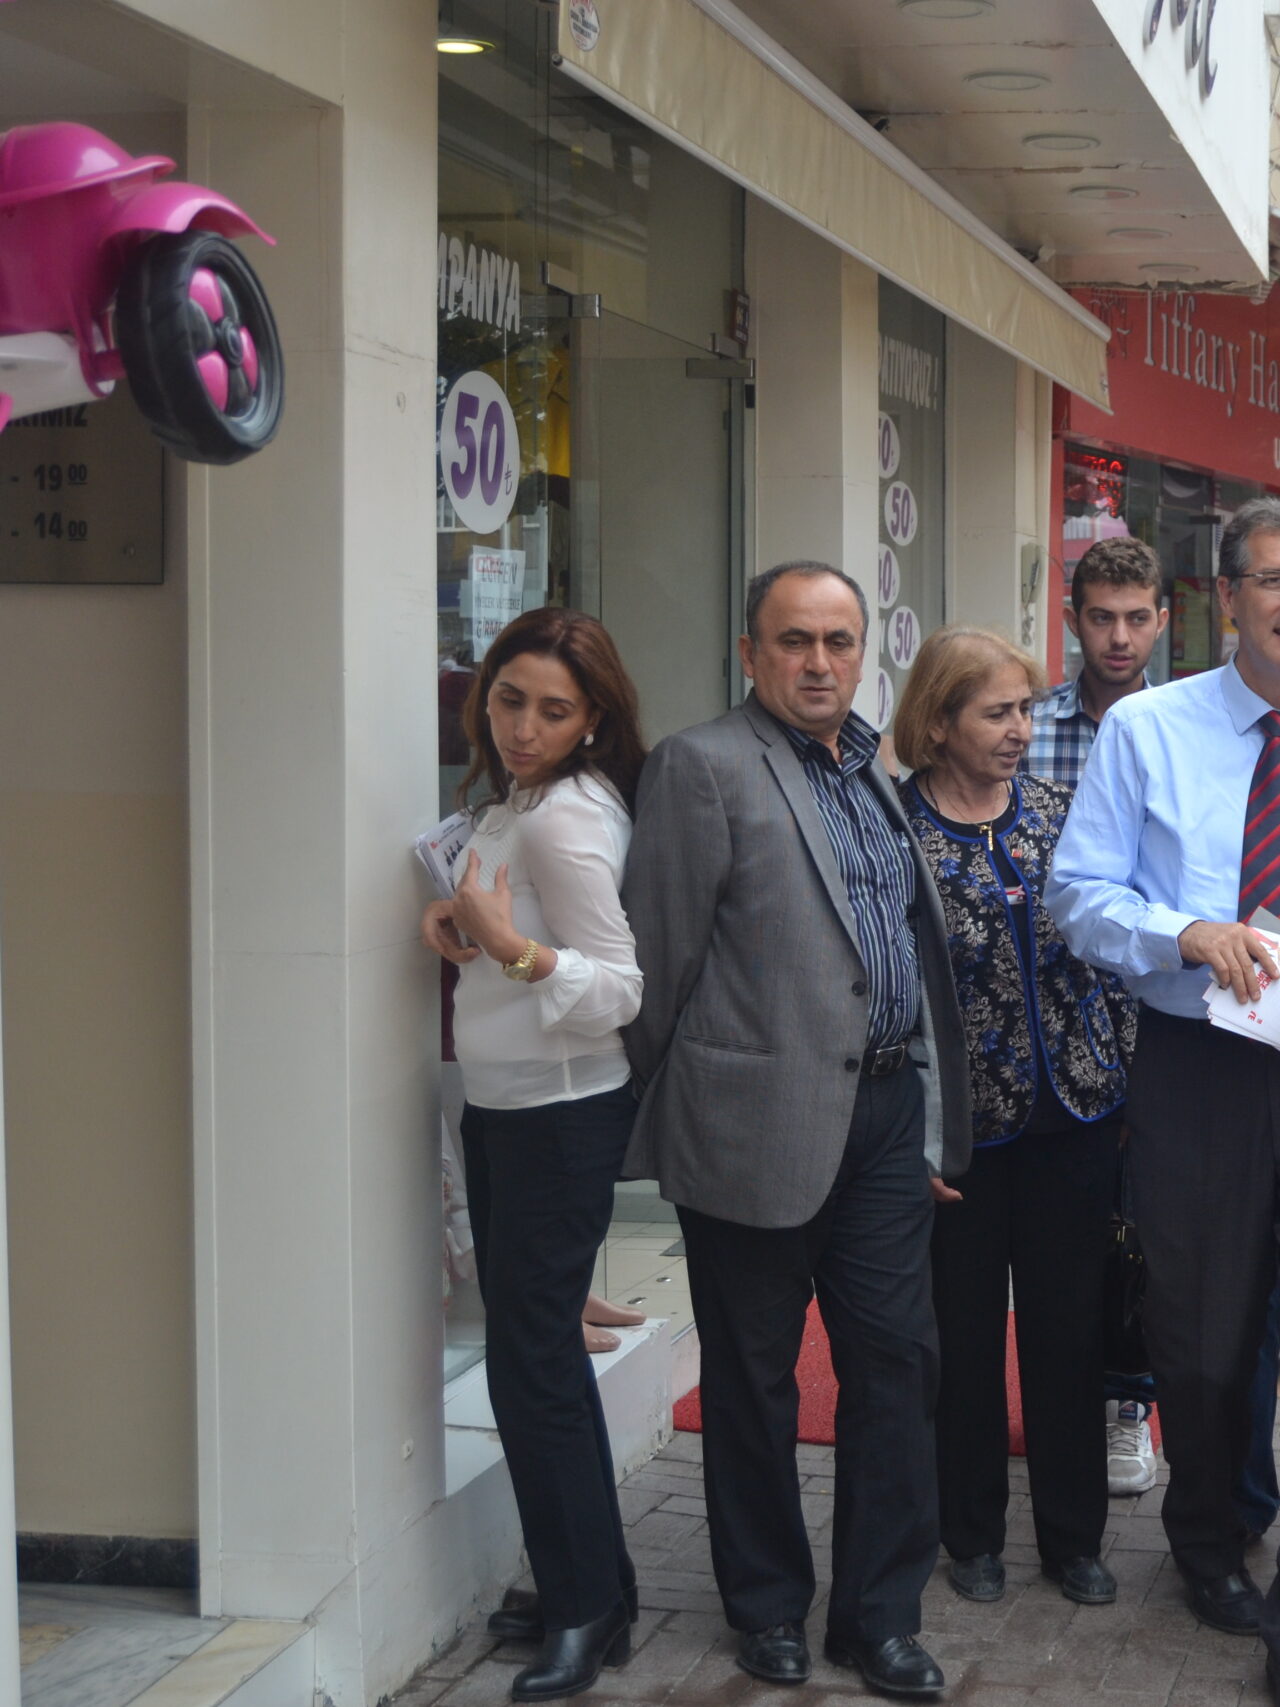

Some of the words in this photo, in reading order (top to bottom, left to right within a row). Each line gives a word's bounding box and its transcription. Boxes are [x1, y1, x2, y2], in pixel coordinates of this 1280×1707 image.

[451, 391, 505, 506] 50
[891, 487, 911, 539] 50
[895, 611, 912, 662] 50
